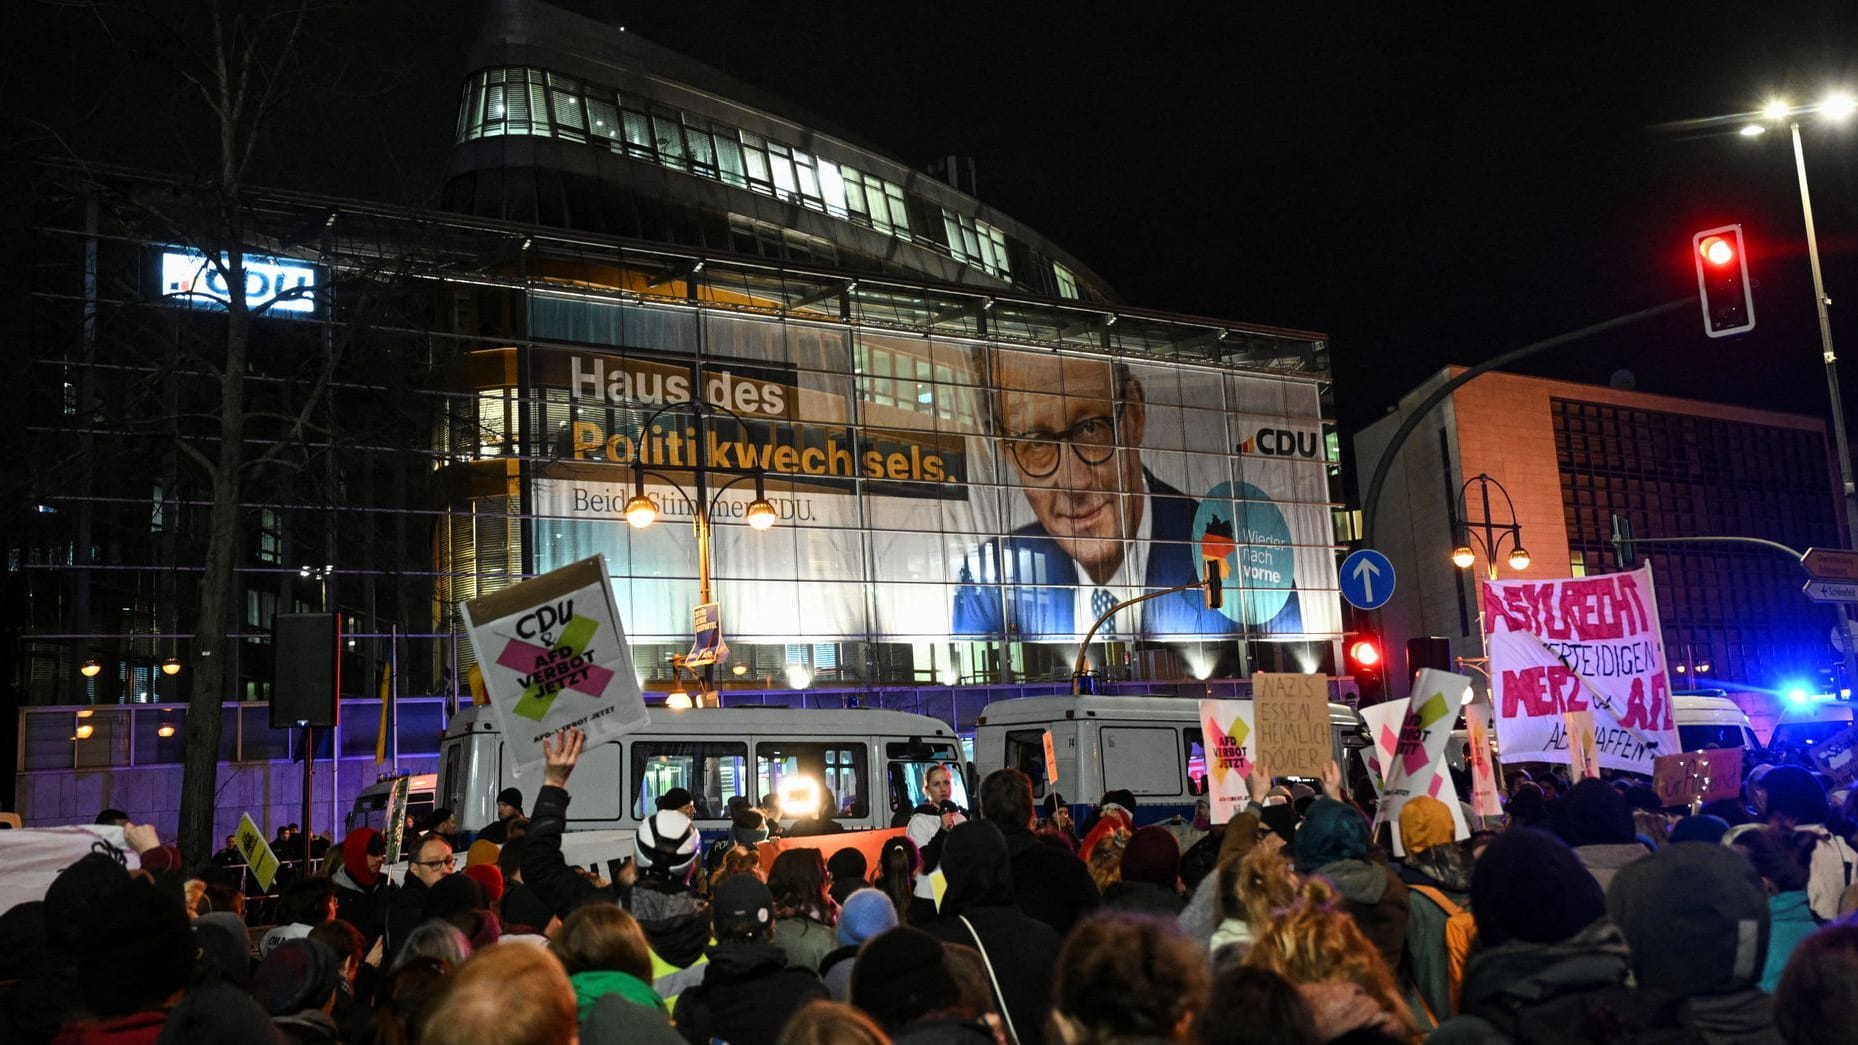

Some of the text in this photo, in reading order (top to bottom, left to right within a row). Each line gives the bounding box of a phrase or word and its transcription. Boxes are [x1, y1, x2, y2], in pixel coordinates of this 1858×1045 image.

[570, 356, 786, 415] Haus des
[1255, 428, 1316, 458] CDU
[573, 488, 628, 514] Beid
[1242, 547, 1273, 565] nach
[1242, 565, 1281, 584] vorne
[516, 599, 574, 639] CDU
[540, 631, 557, 647] &
[516, 649, 595, 688] VERBOT
[534, 645, 573, 669] AFD
[534, 666, 590, 698] JETZT
[1262, 676, 1314, 698] NAZIS
[1261, 702, 1310, 721] ESSEN
[1218, 736, 1237, 746] AFD
[1260, 722, 1331, 745] HEIMLICH
[1213, 747, 1247, 758] VERBOT
[1218, 758, 1245, 769] JETZT
[1262, 745, 1321, 770] DÖNER
